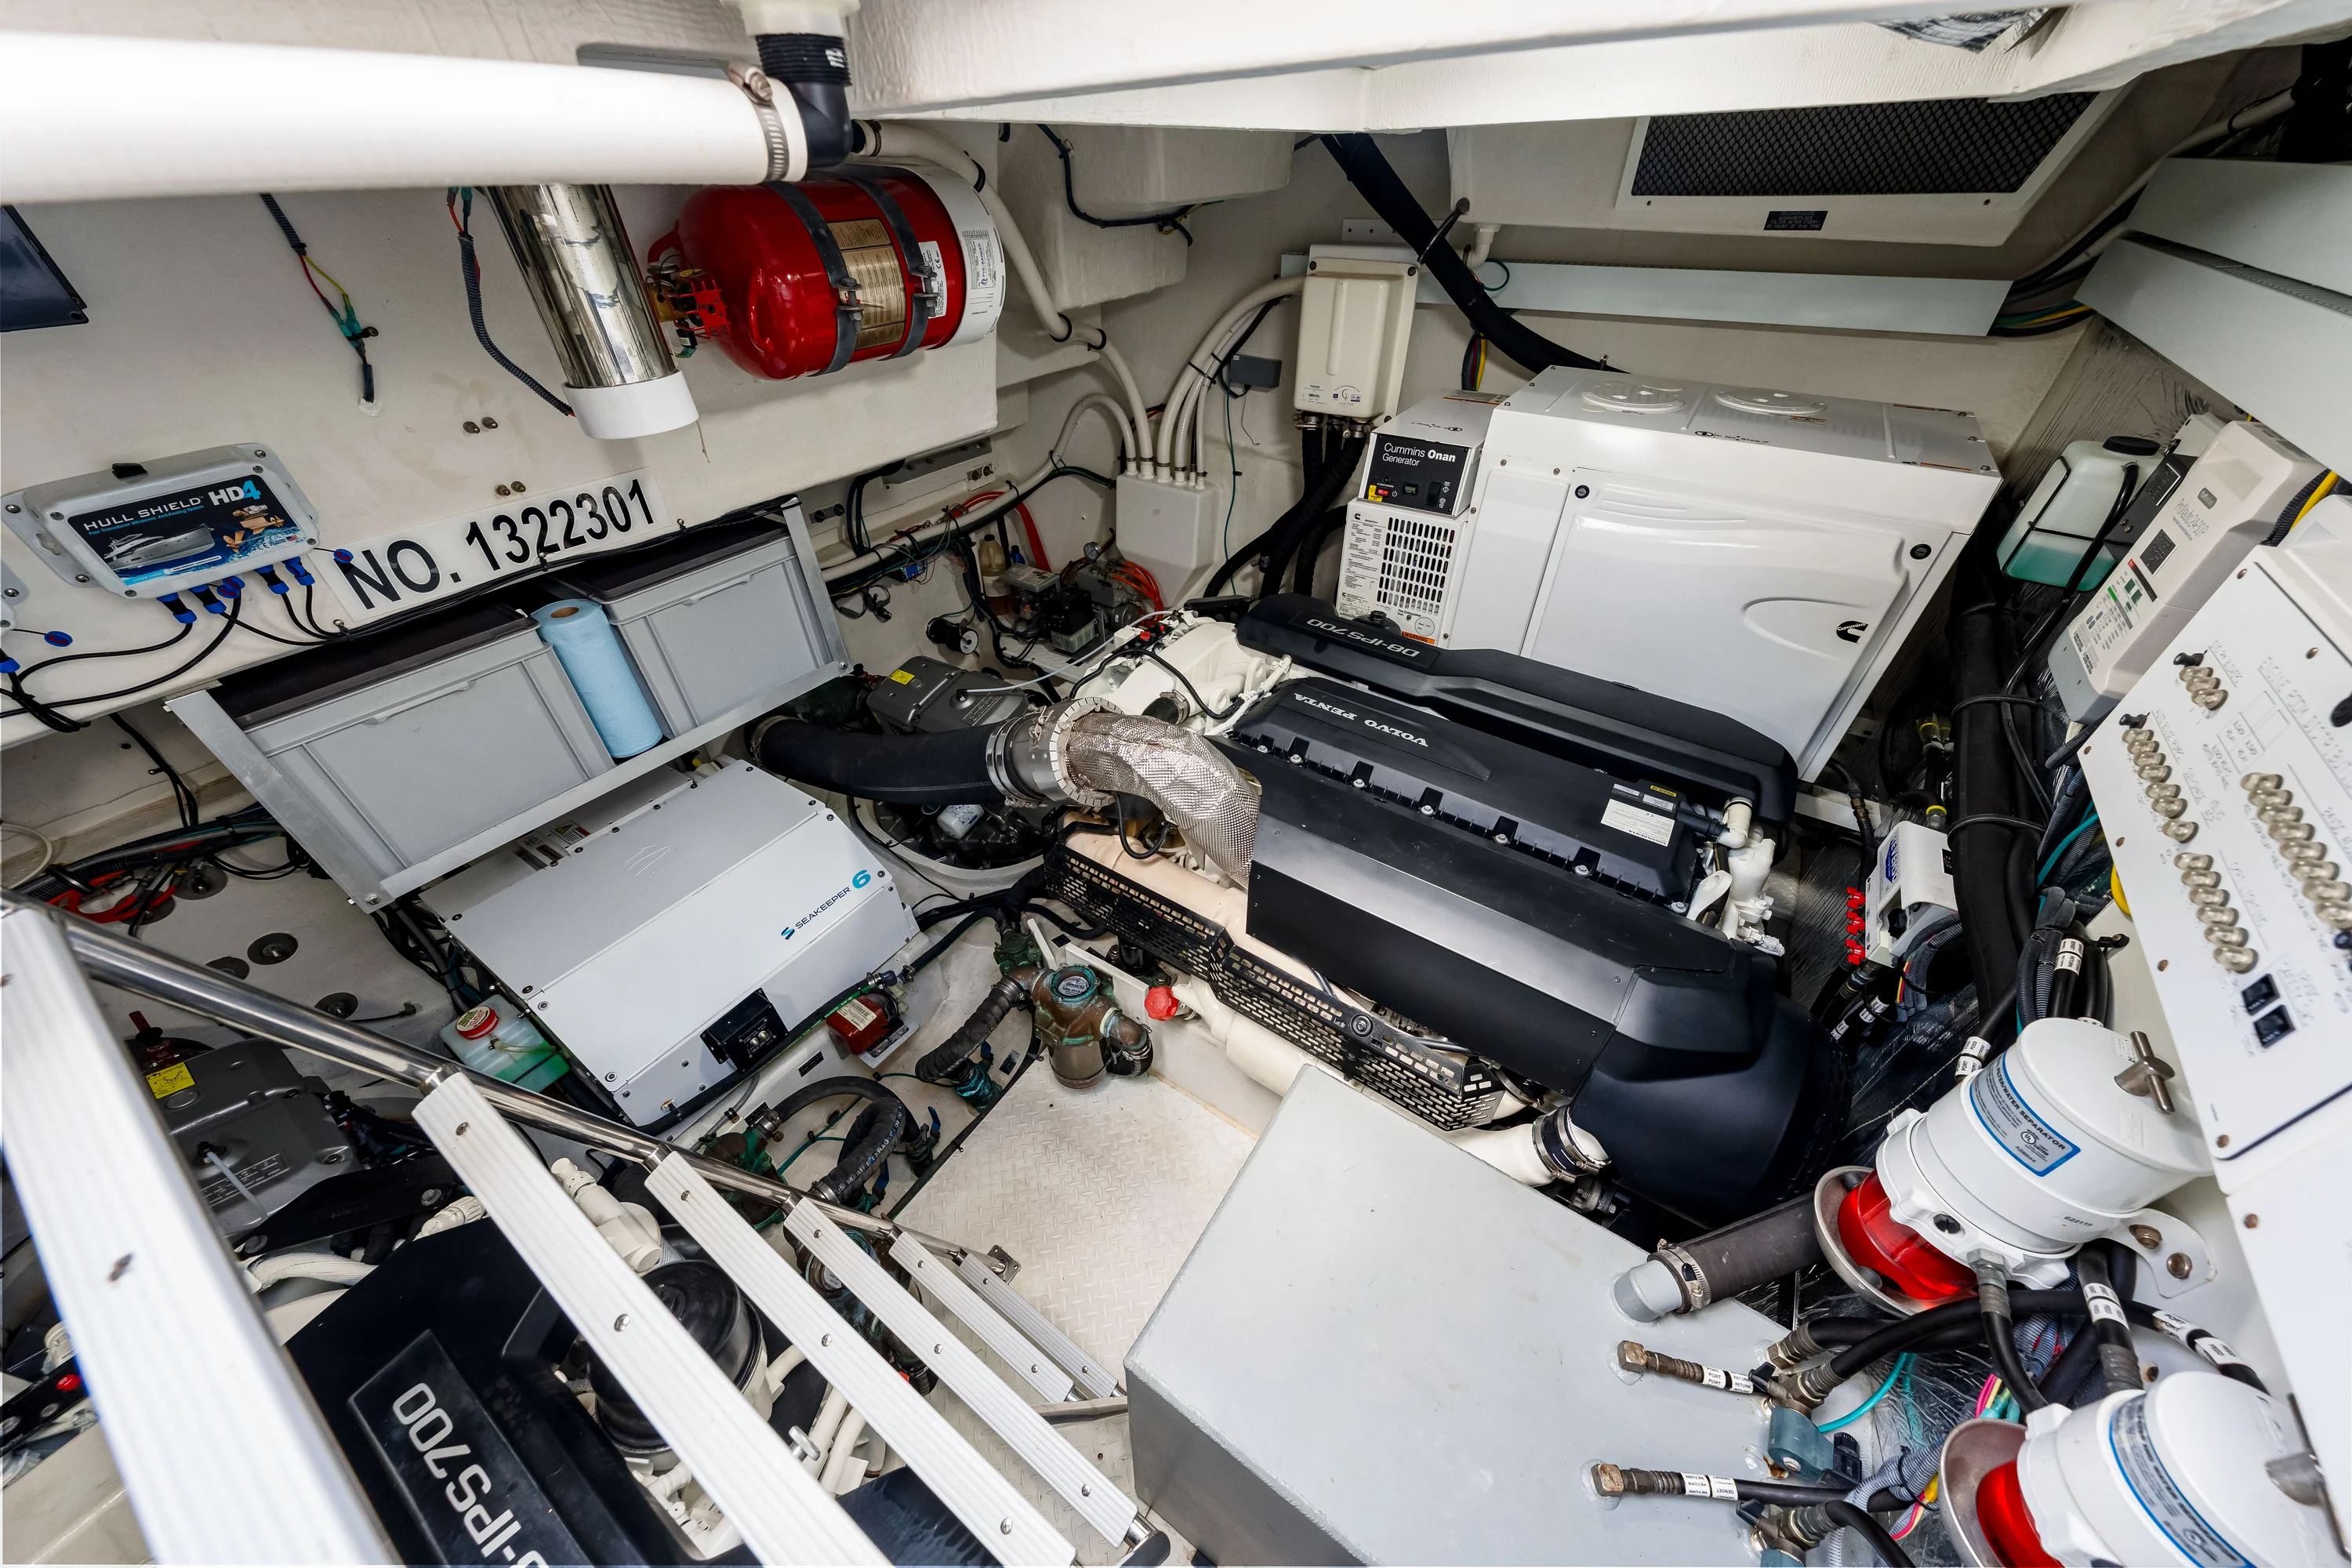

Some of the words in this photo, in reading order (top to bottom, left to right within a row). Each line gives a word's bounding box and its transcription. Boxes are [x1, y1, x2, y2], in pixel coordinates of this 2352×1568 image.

[1382, 453, 1421, 466] Generator
[1384, 442, 1425, 458] Cummins
[1428, 449, 1456, 463] Onan
[83, 512, 134, 531] HULL
[137, 497, 202, 518] SHIELD
[208, 480, 262, 506] HD4
[101, 521, 131, 534] Transducer
[131, 516, 157, 526] Ultrasonic
[158, 508, 187, 519] Anti-Fouling
[187, 504, 205, 514] System
[332, 539, 463, 610] NO.
[465, 478, 655, 572] 1322301
[1404, 633, 1428, 642] WARNING
[1294, 692, 1358, 720] PENTA
[1364, 720, 1428, 747] VOLVO
[795, 886, 851, 929] SEAKEEPER
[852, 869, 871, 889] 6
[1996, 1067, 2020, 1109] FILTER/WATER
[2020, 1109, 2067, 1151] SEPARATOR
[2024, 1134, 2032, 1143] UL
[2209, 1344, 2224, 1356] FEED
